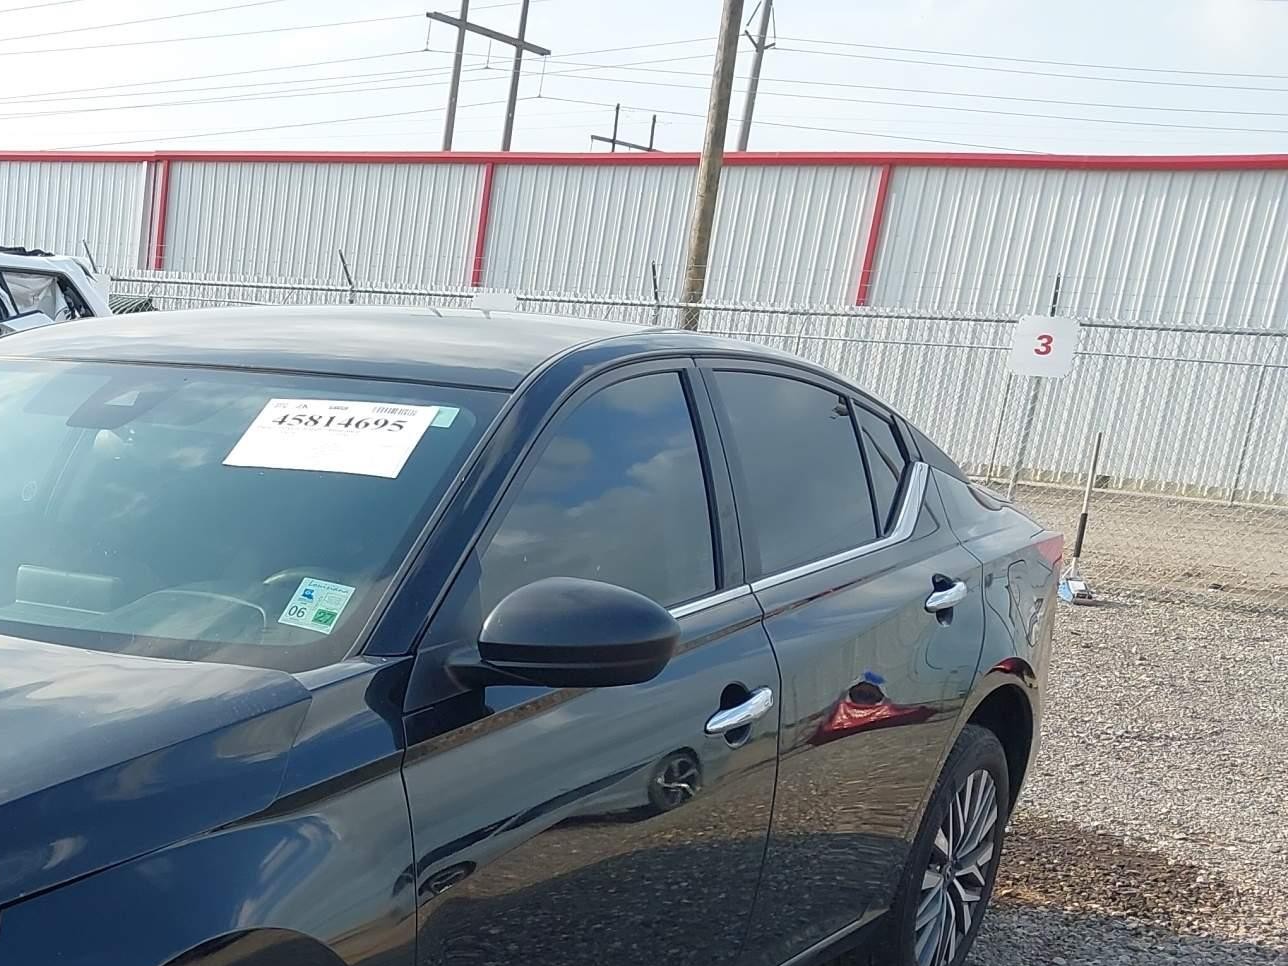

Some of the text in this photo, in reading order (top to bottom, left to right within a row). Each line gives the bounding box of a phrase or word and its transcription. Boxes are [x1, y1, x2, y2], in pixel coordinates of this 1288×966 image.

[1034, 334, 1054, 356] 3
[272, 413, 409, 433] 45814695
[288, 605, 307, 618] 06
[316, 611, 336, 624] 27
